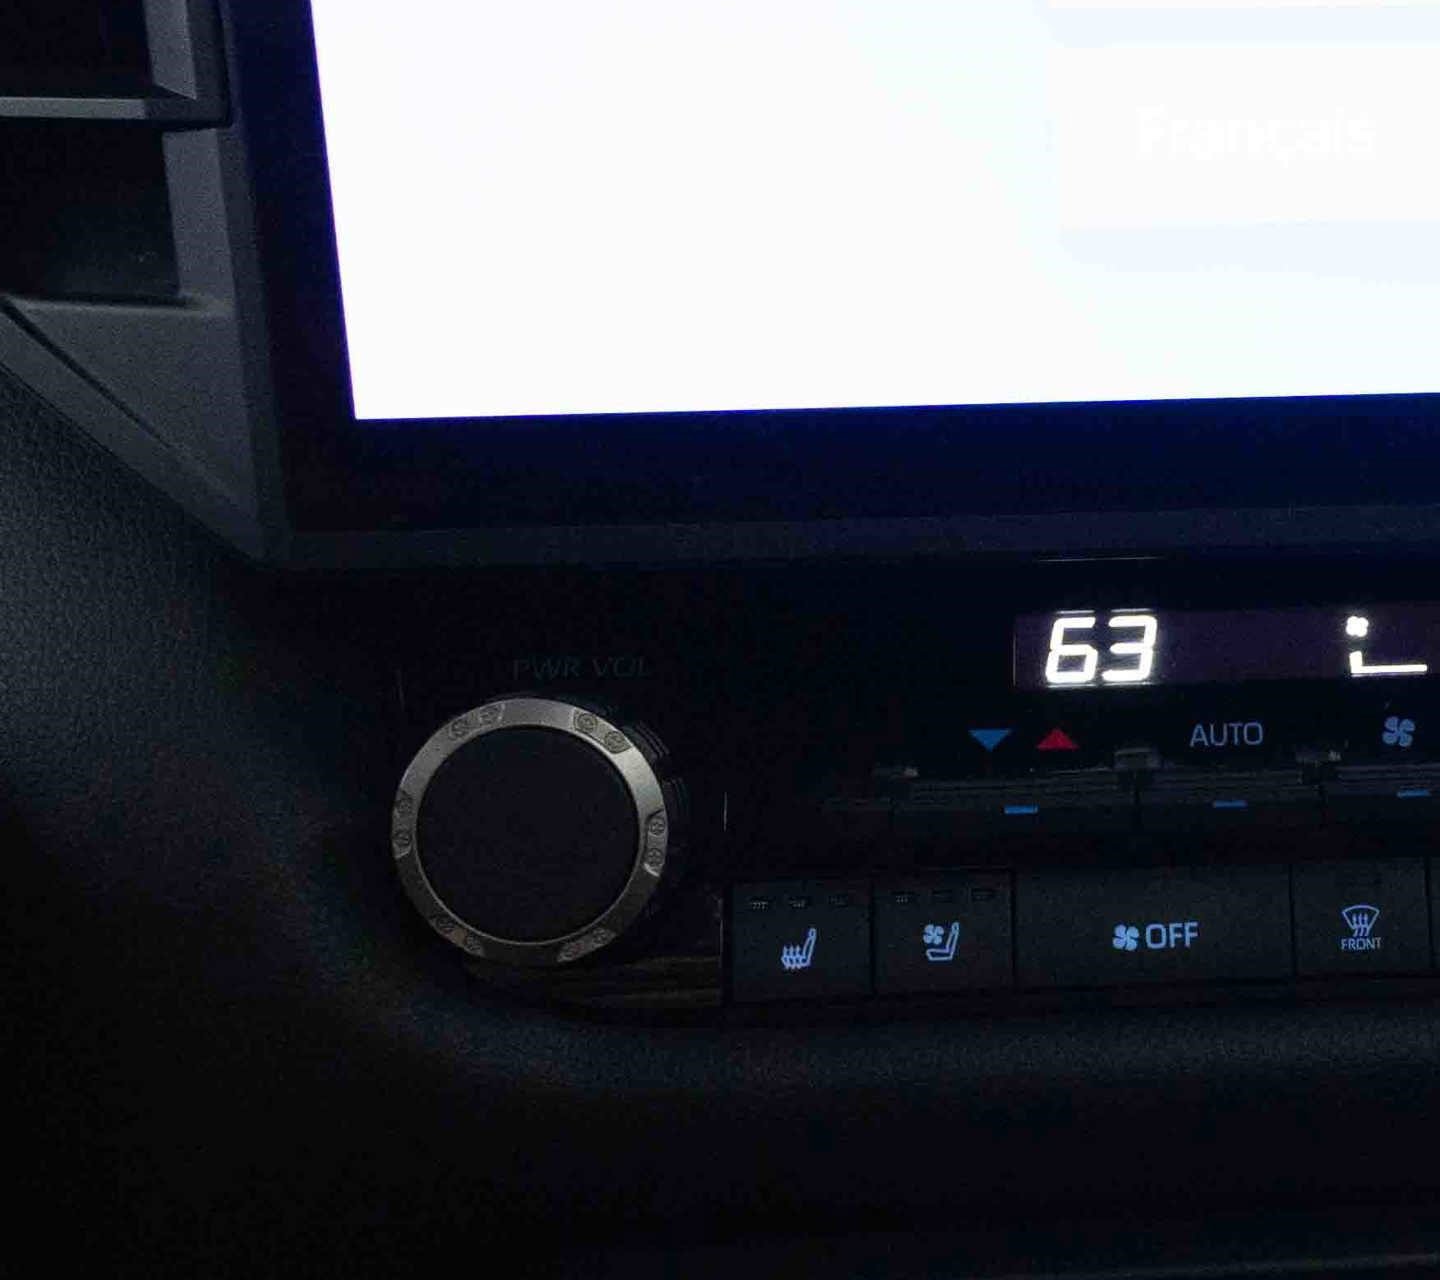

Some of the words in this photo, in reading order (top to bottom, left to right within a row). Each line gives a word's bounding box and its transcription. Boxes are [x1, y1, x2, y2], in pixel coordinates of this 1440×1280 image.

[1135, 102, 1378, 166] Français
[1045, 615, 1158, 684] 63
[1189, 721, 1264, 747] AUTO
[1145, 921, 1199, 949] OFF
[1341, 936, 1382, 951] FRONT
